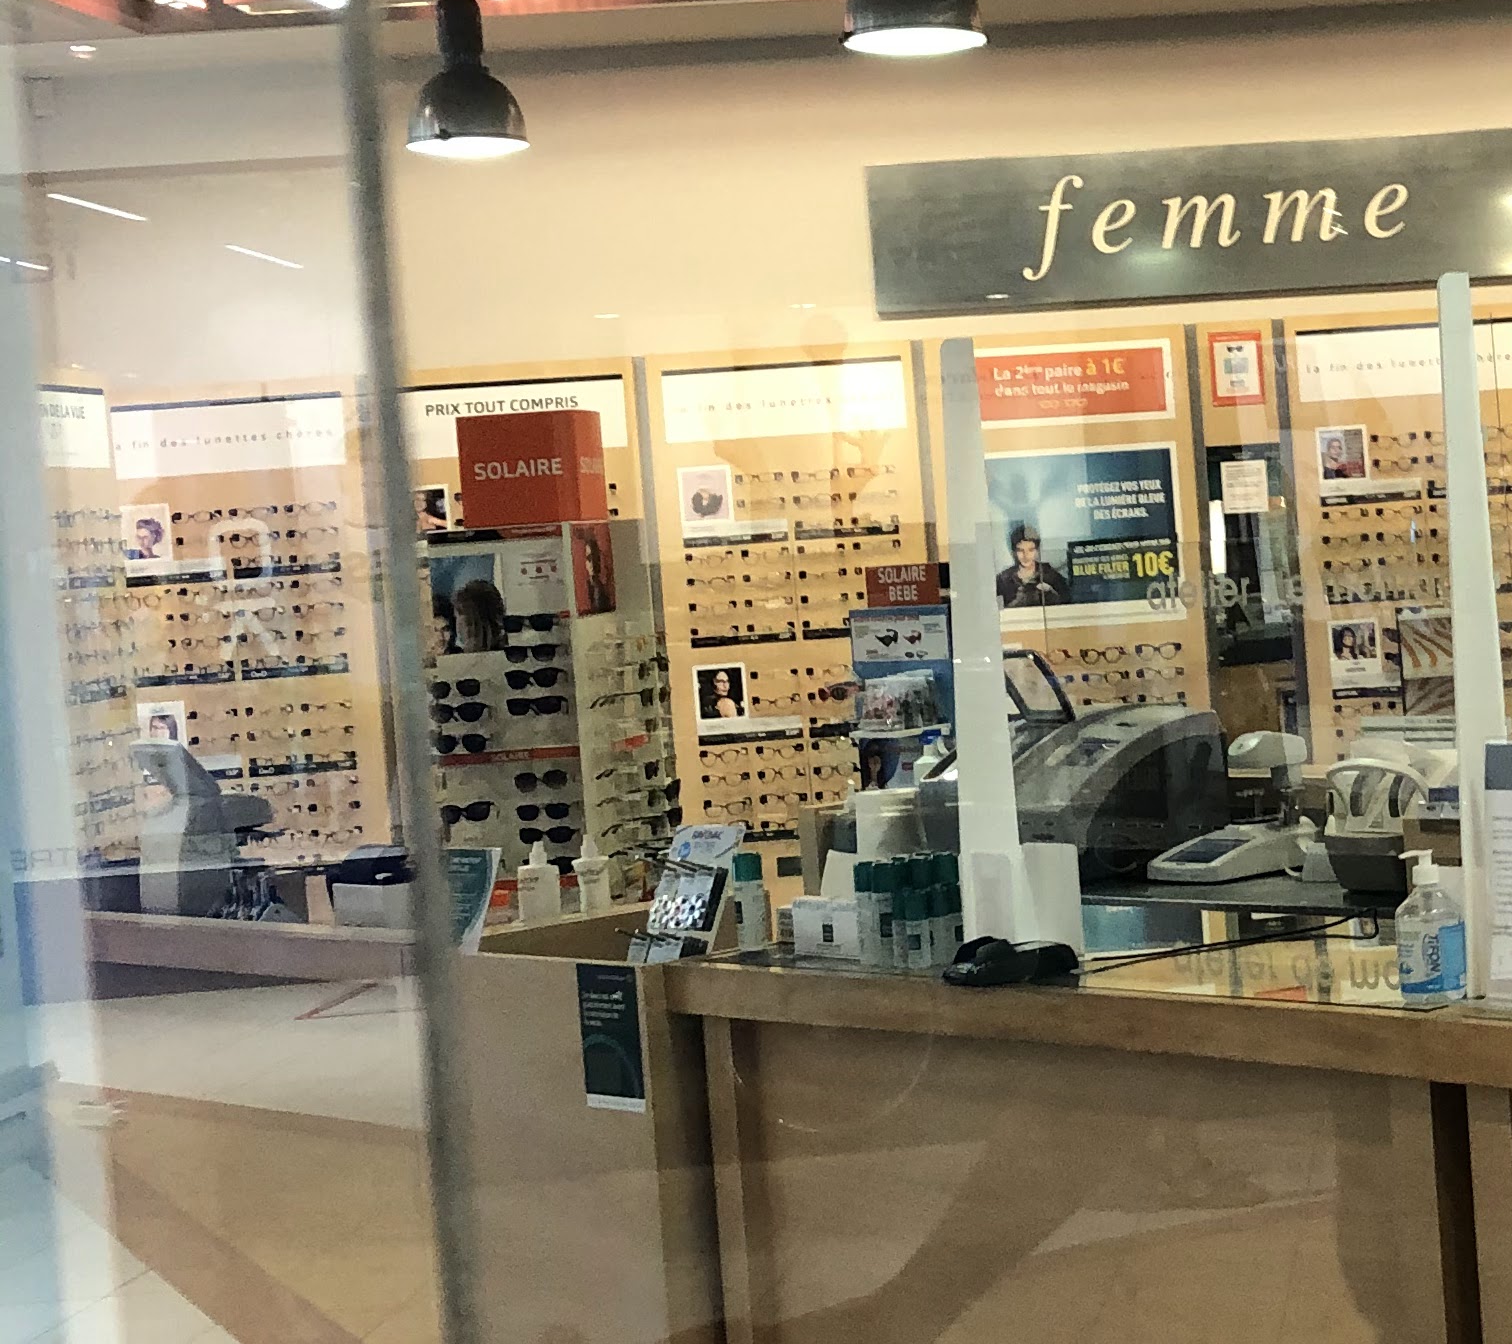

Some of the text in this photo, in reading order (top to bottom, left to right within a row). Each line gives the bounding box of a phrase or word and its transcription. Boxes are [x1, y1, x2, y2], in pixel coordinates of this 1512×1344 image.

[1023, 174, 1409, 282] femme
[993, 367, 1011, 381] La
[1045, 363, 1082, 381] paire
[1102, 357, 1126, 375] 1€
[994, 382, 1028, 397] dans
[1031, 381, 1060, 395] tout
[425, 395, 579, 417] PRIX TOUT COMPRIS
[473, 457, 564, 481] SOLAIRE
[878, 565, 926, 584] SOLAIRE
[1132, 550, 1174, 577] 10€
